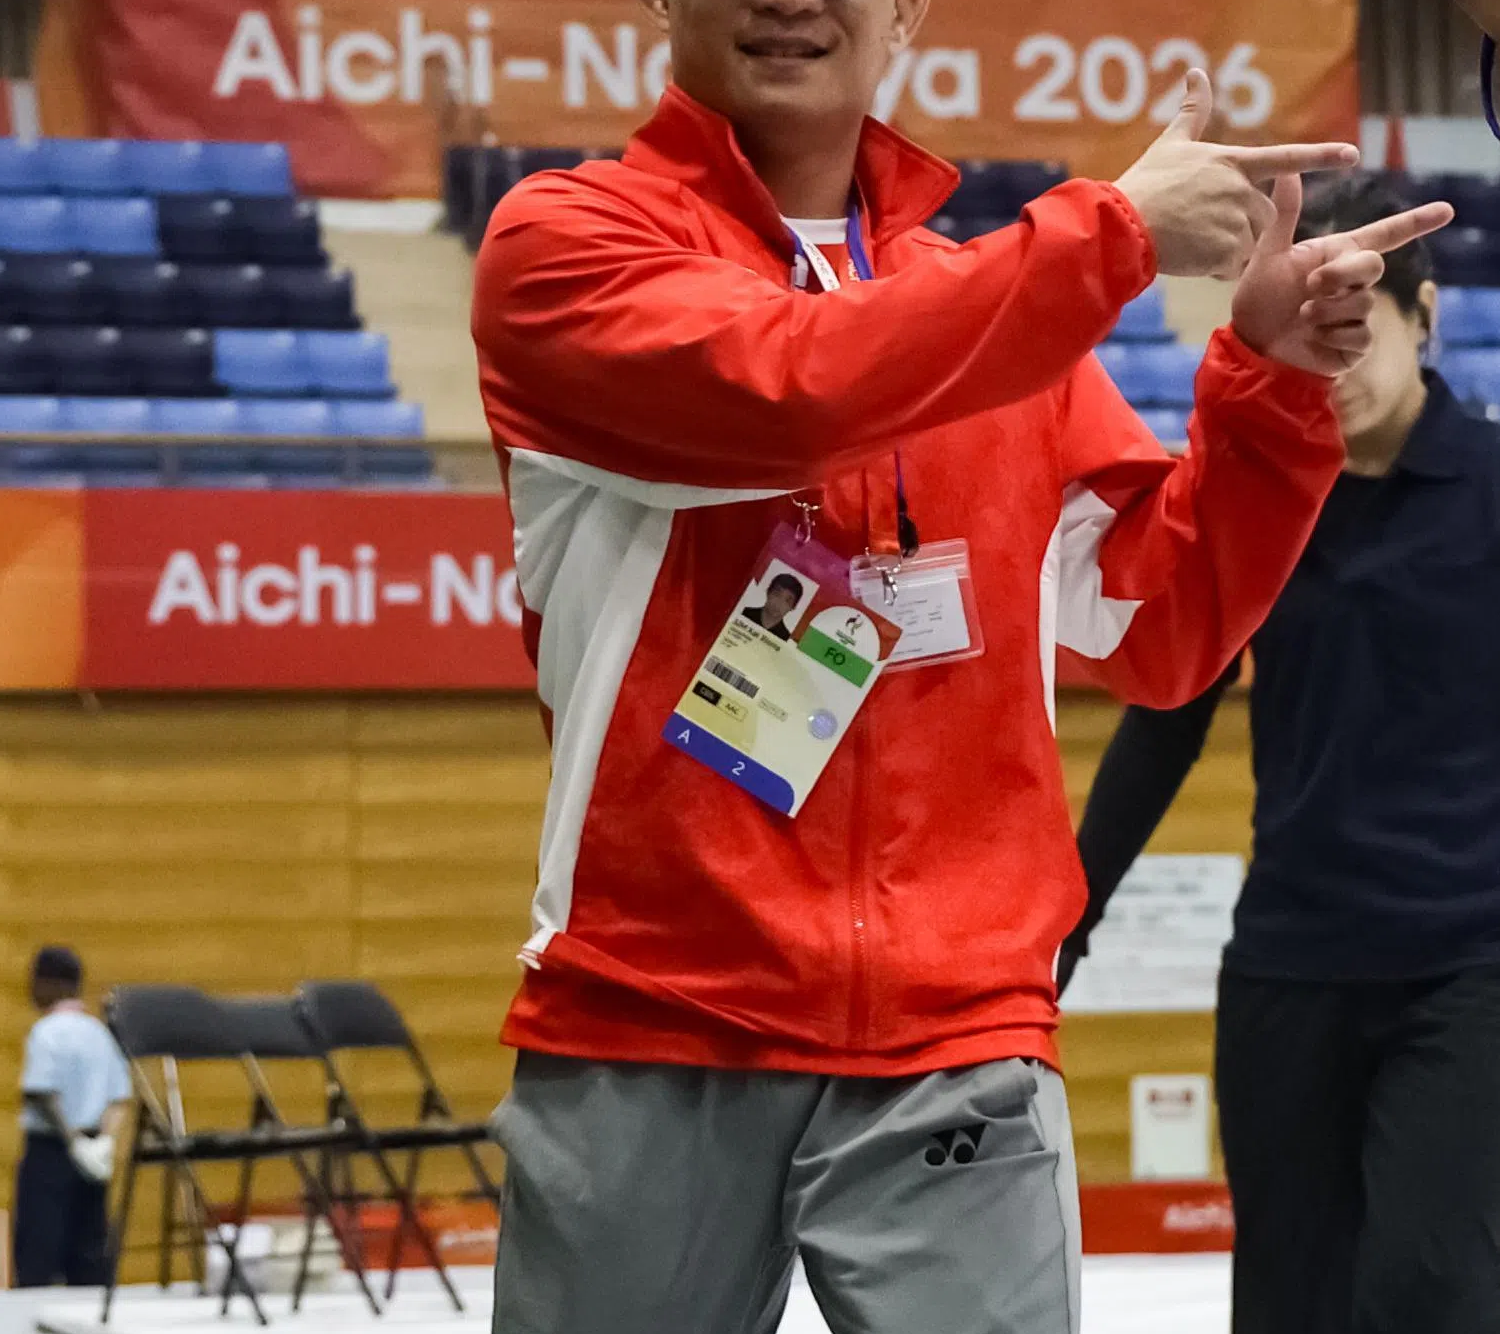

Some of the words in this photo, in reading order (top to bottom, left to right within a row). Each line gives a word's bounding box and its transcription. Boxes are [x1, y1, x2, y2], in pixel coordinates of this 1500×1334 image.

[1014, 33, 1276, 128] 2026
[824, 646, 846, 667] FO
[677, 729, 691, 744] A
[732, 761, 746, 776] 2
